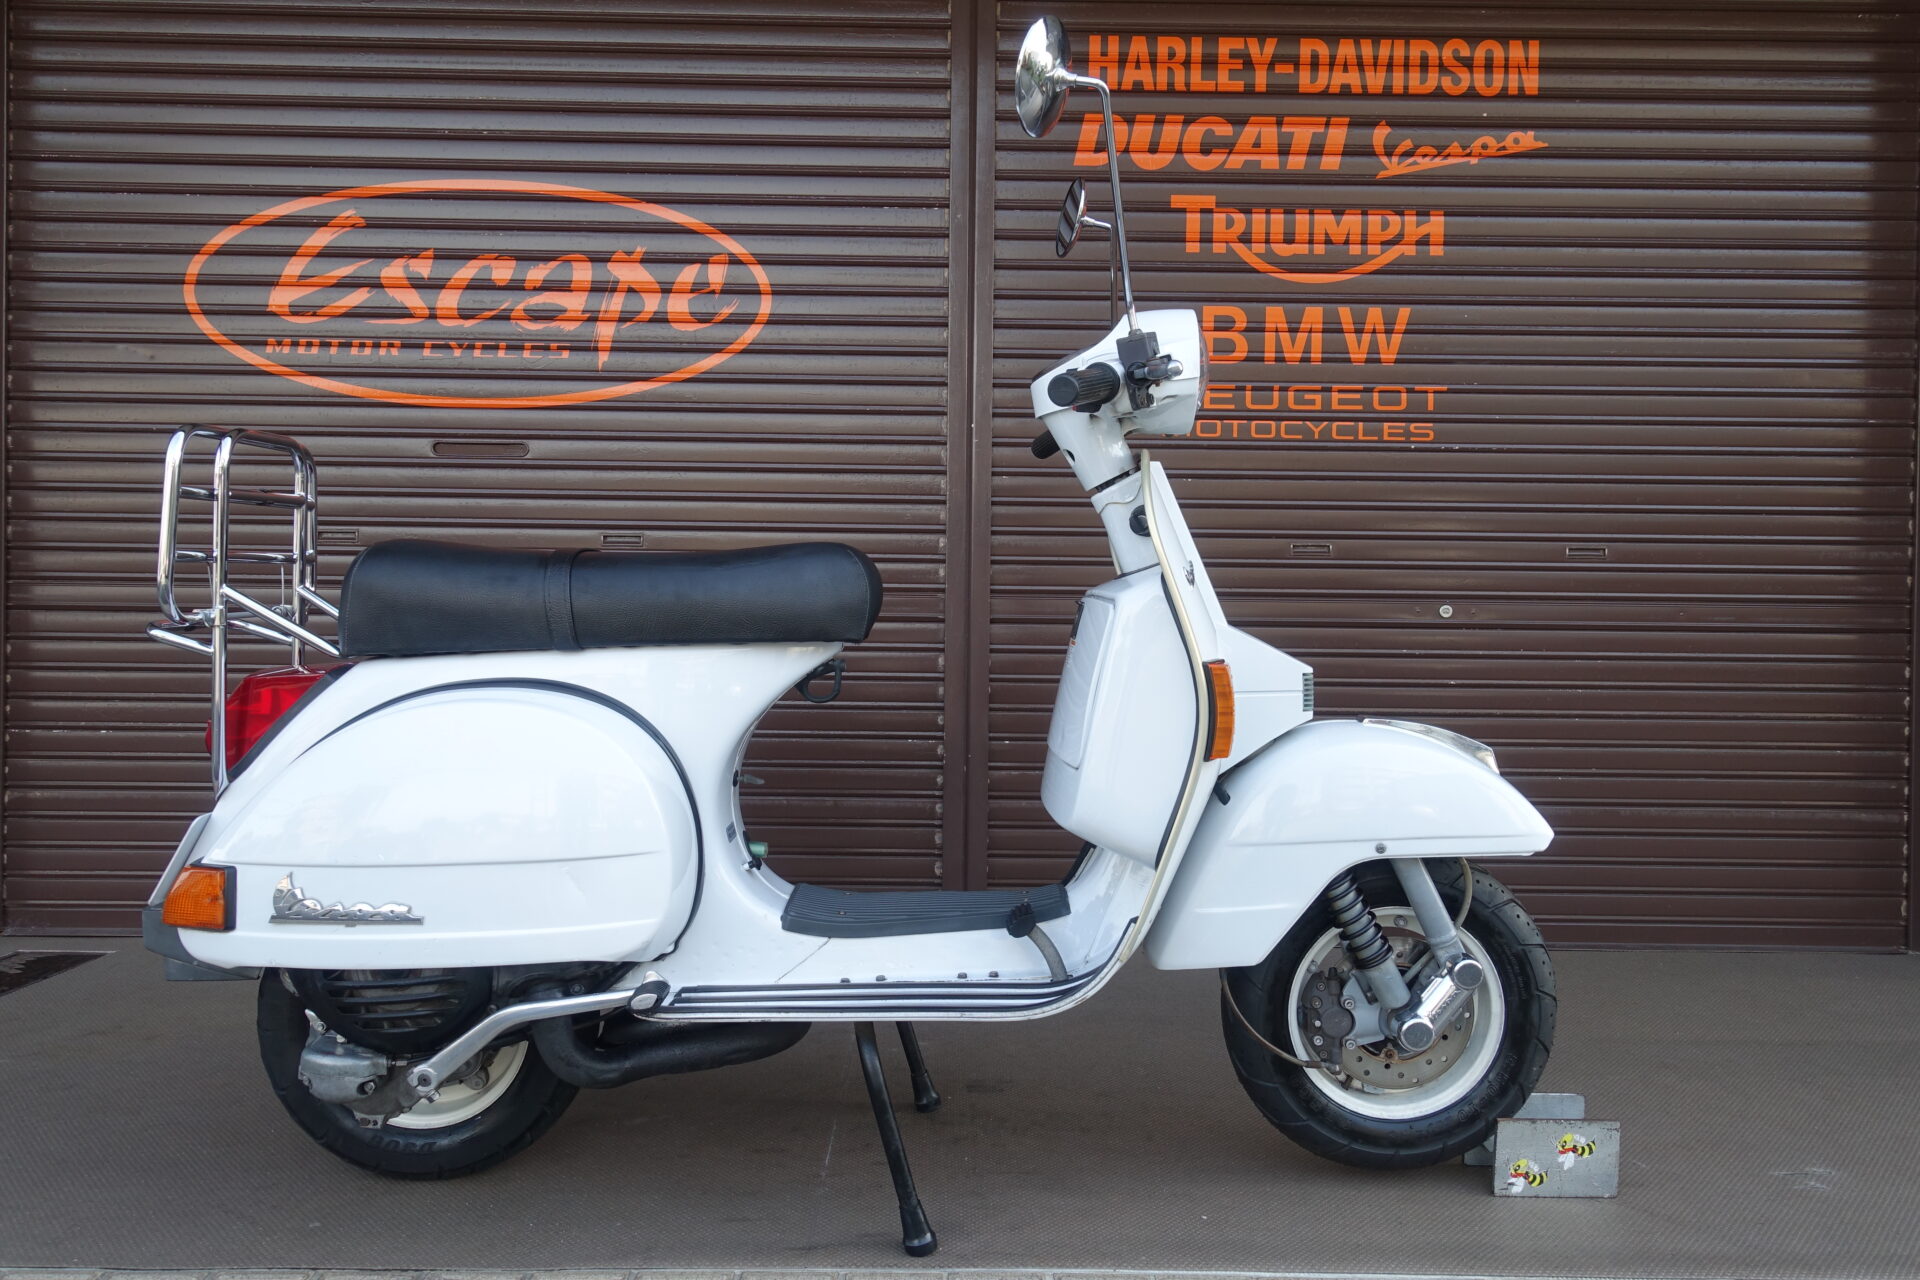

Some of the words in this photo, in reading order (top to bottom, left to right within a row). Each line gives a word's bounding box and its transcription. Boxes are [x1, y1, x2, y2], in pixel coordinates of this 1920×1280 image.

[1087, 35, 1540, 96] HARLEY-DAVIDSON
[1073, 114, 1350, 171] DUCATI
[1372, 119, 1549, 180] Vespa
[1170, 194, 1445, 284] TRIUMPH
[267, 208, 740, 372] Escape
[265, 338, 402, 355] MOTOR
[423, 341, 571, 359] CYCLES
[1201, 305, 1412, 366] BMW
[1202, 384, 1448, 411] EUGEOT
[1161, 419, 1435, 441] OTOCYCLES
